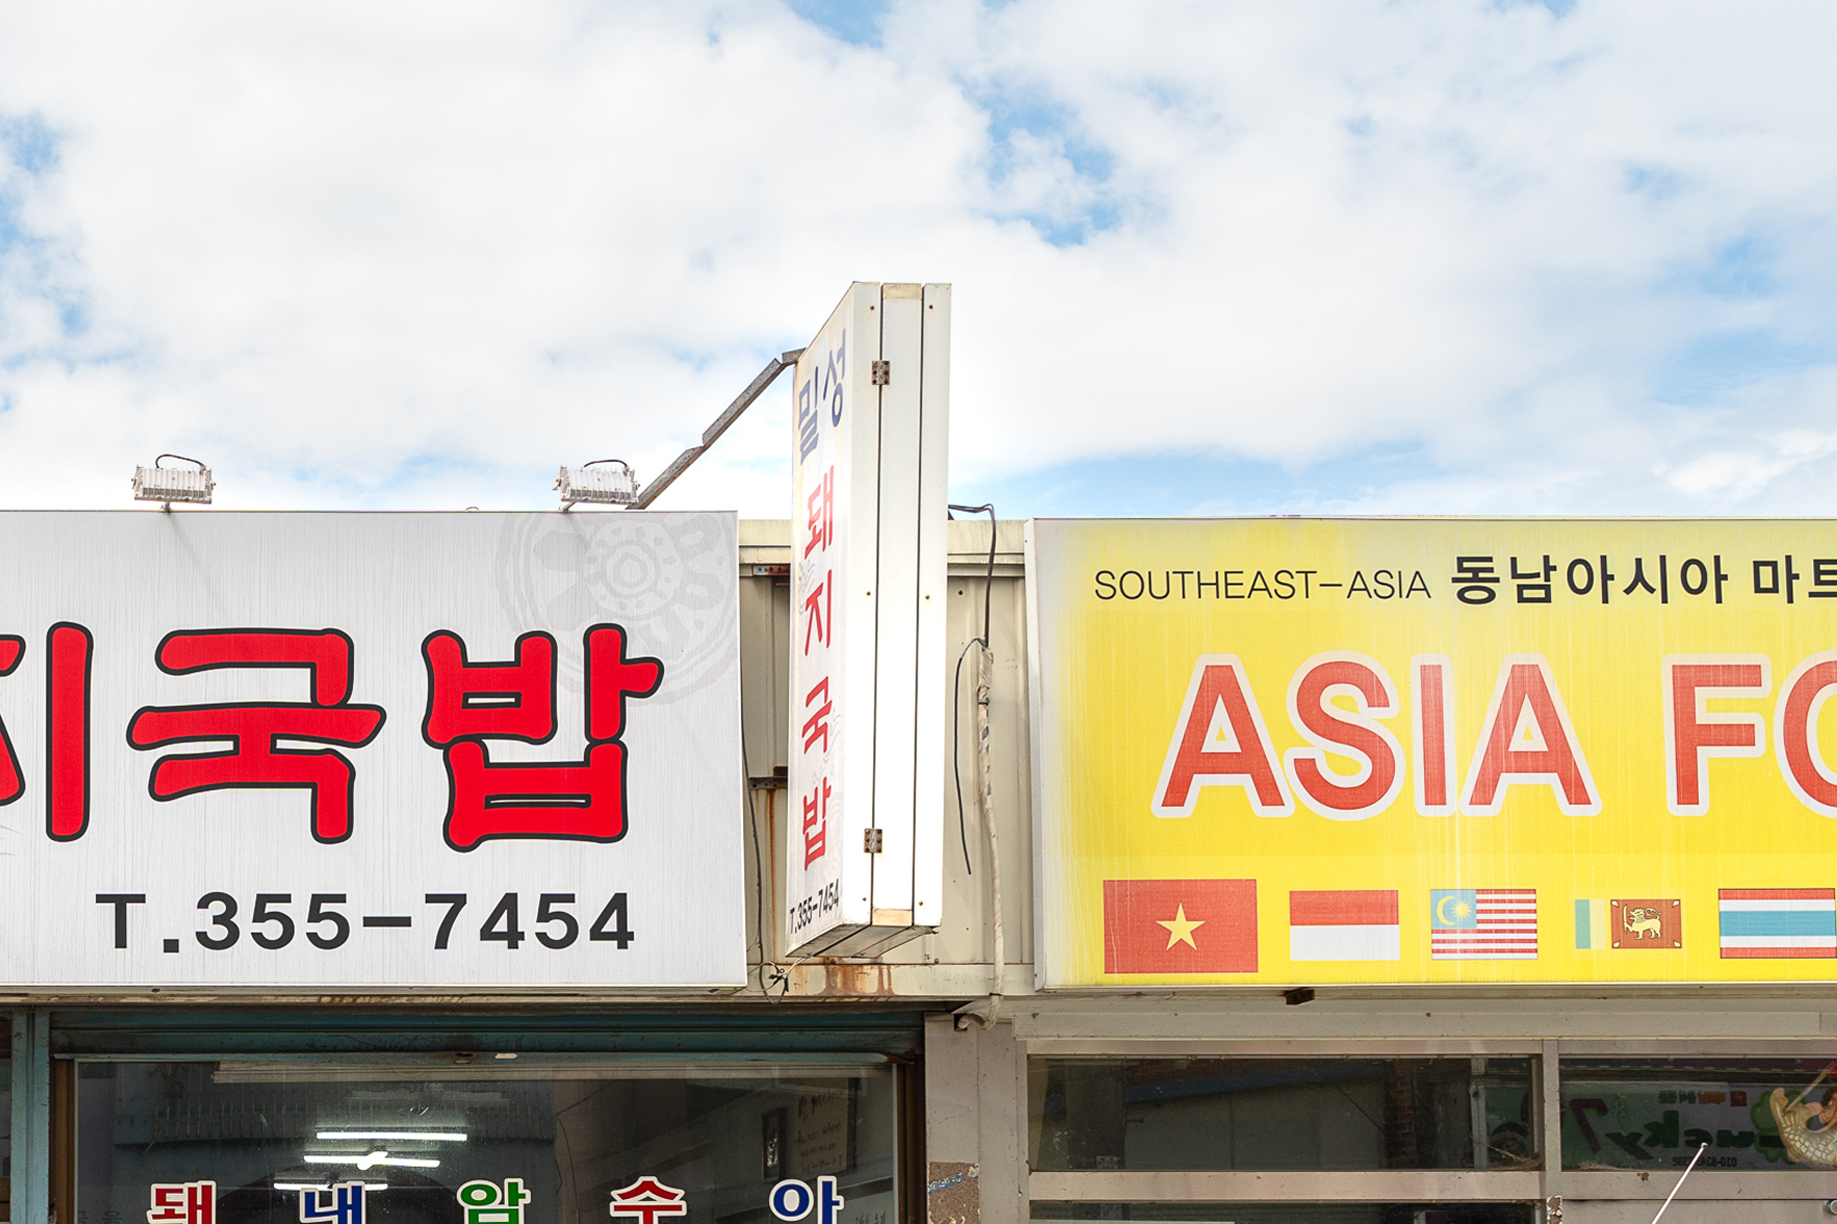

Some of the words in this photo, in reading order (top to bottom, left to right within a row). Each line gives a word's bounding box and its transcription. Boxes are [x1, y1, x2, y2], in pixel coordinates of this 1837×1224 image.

[798, 328, 846, 465] 밀성
[1094, 569, 1431, 600] SOUTHEAST-ASIA
[1450, 555, 1728, 605] 동남아시아
[801, 465, 835, 872] 돼지국밥
[1159, 660, 1596, 812] ASIA
[95, 890, 636, 954] T.355-7454
[789, 877, 840, 935] T.355-7454
